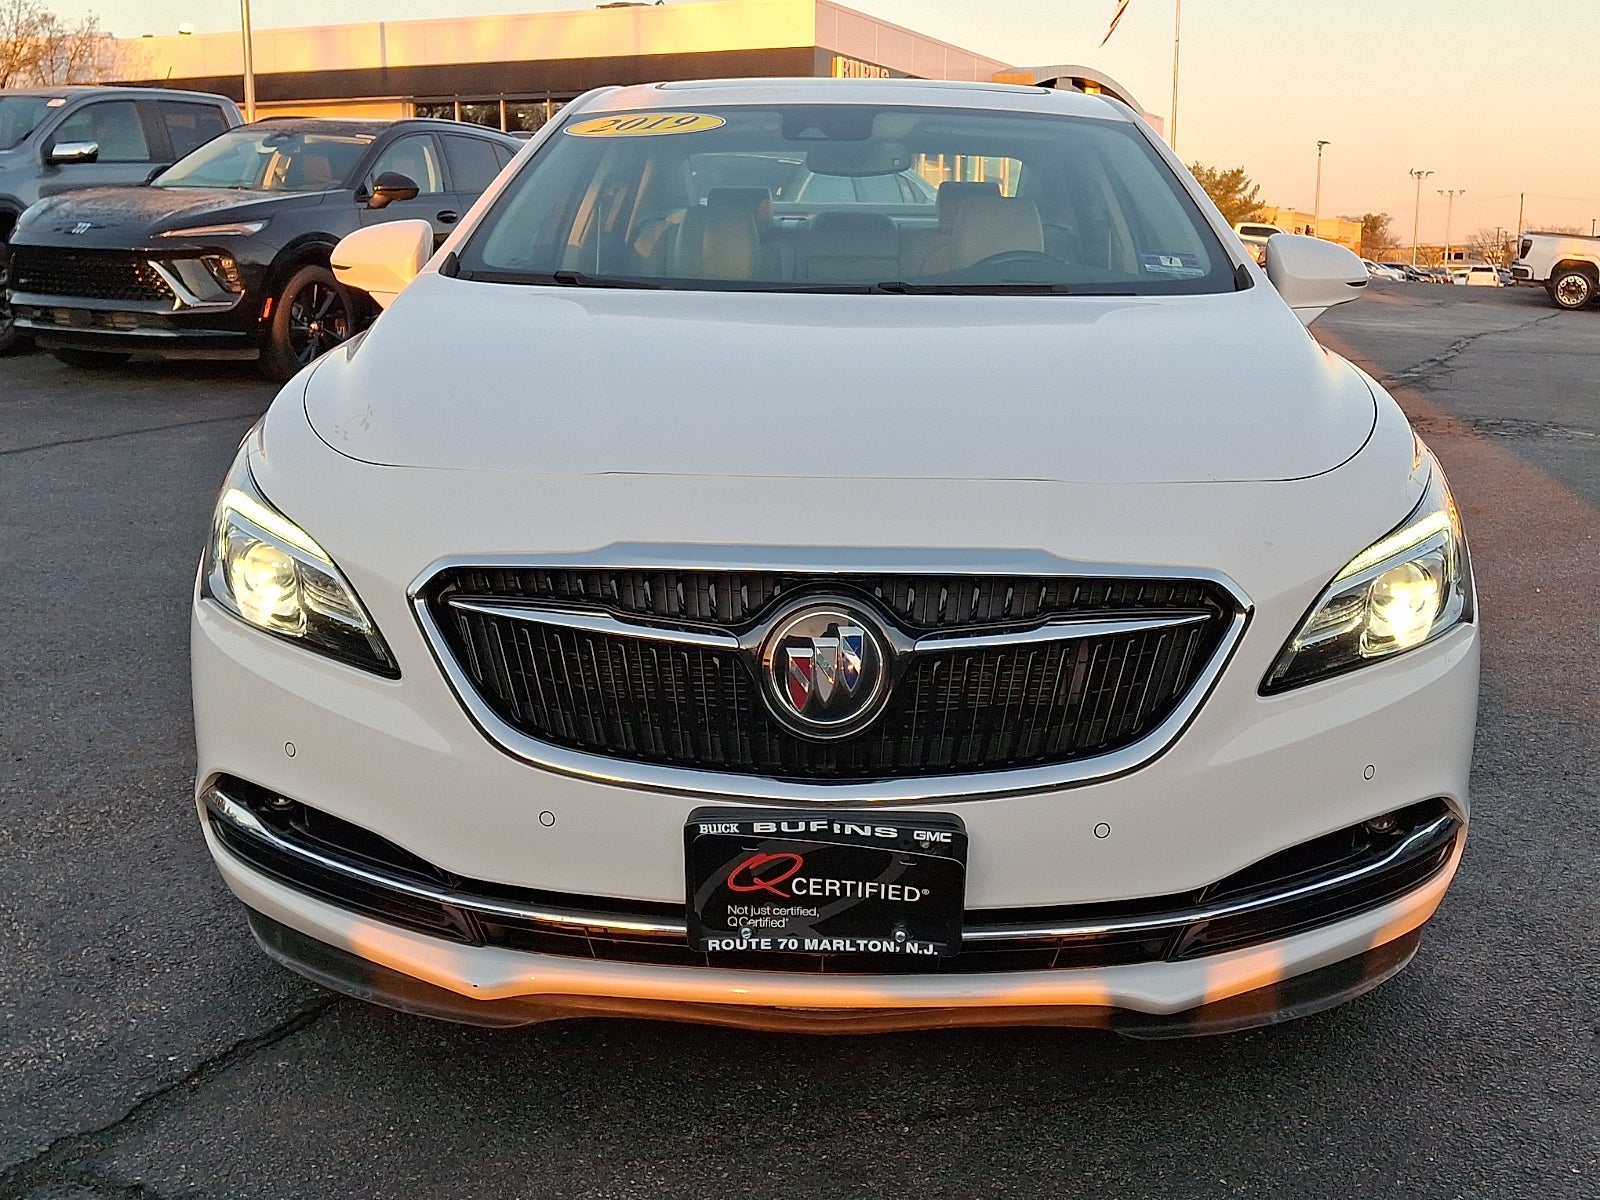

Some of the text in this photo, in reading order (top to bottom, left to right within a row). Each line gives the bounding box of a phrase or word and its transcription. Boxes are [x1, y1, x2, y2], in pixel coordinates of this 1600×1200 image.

[587, 115, 700, 133] 2019
[699, 823, 740, 835] BUICK
[913, 831, 952, 843] GMC
[727, 905, 820, 918] Not just certified,
[708, 938, 938, 955] ROUTE 70 MARLTON, N.J.
